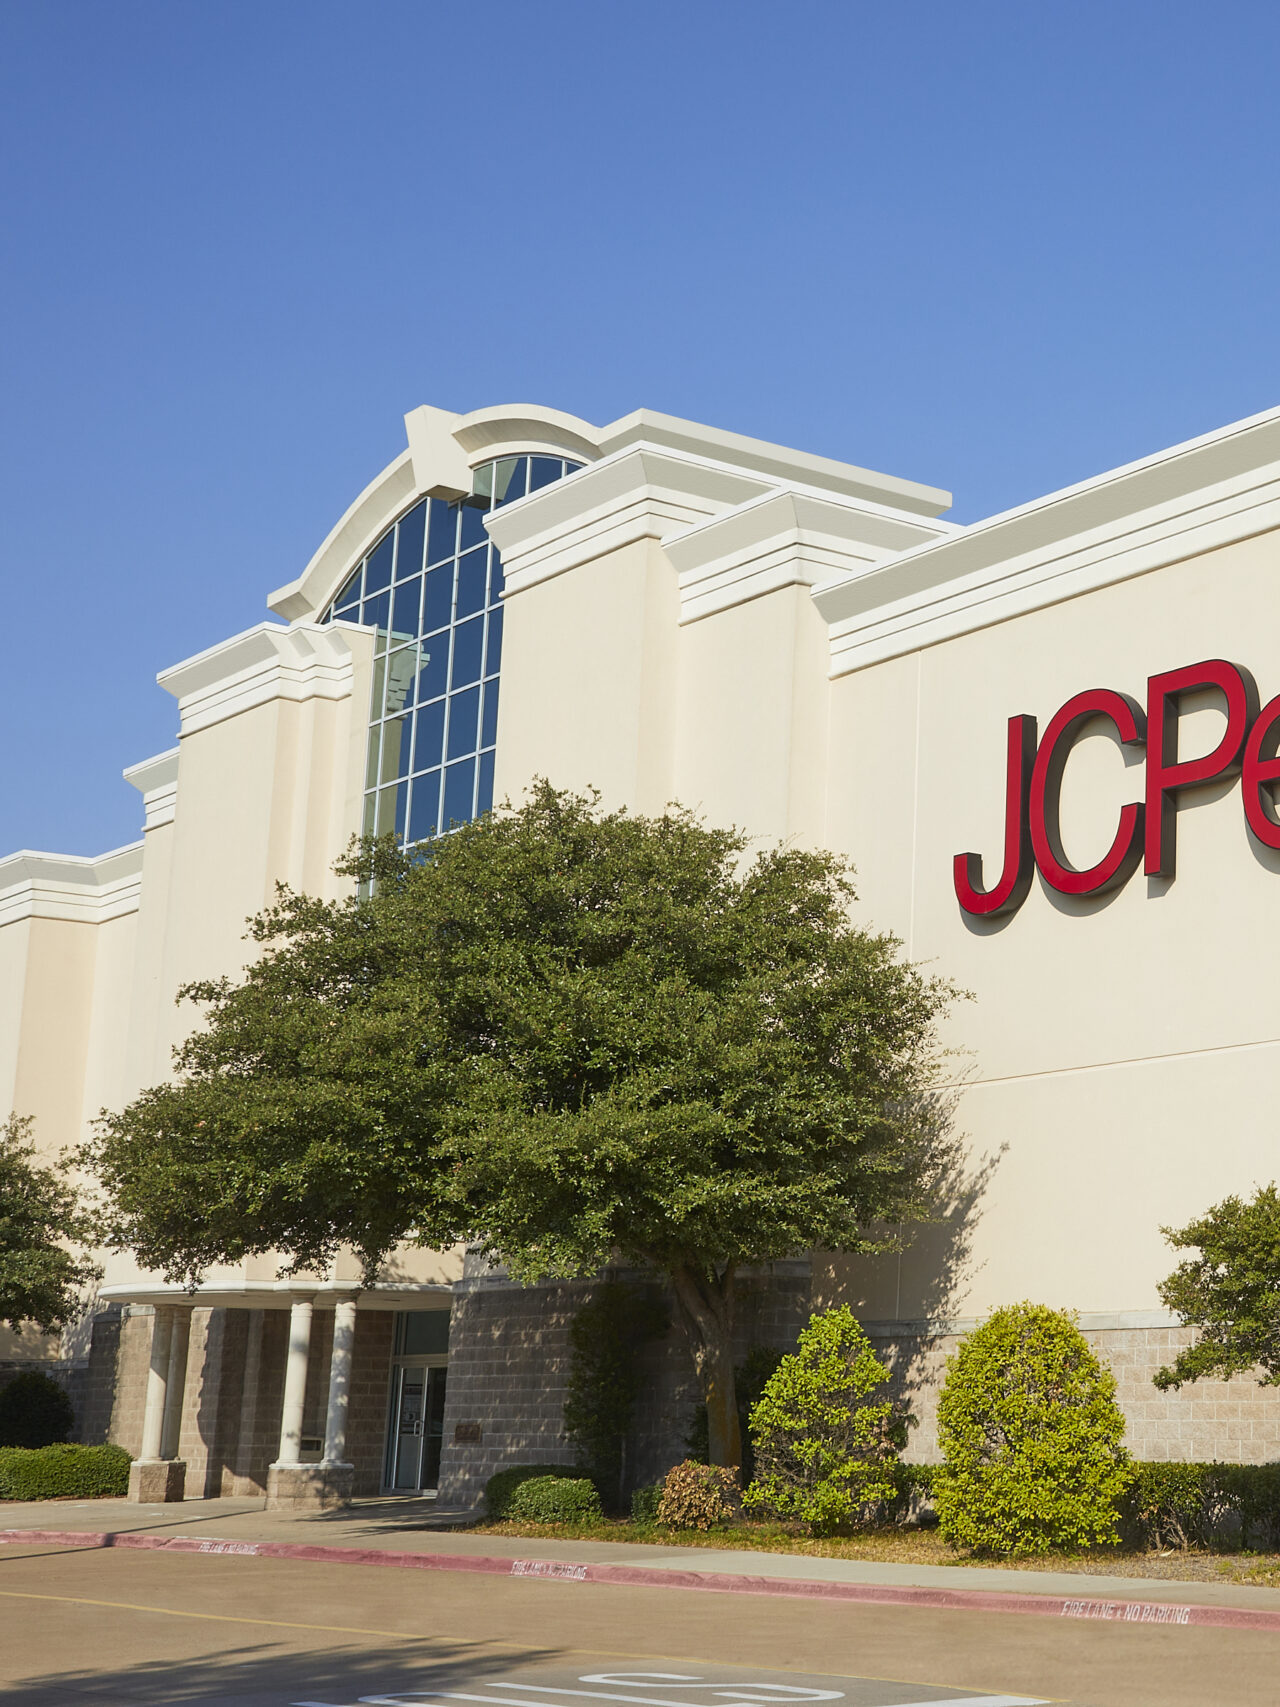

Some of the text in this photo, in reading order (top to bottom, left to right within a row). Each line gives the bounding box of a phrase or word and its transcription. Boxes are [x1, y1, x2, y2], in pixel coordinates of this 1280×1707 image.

[1061, 1601, 1190, 1624] FIRE LANE NO PARKING
